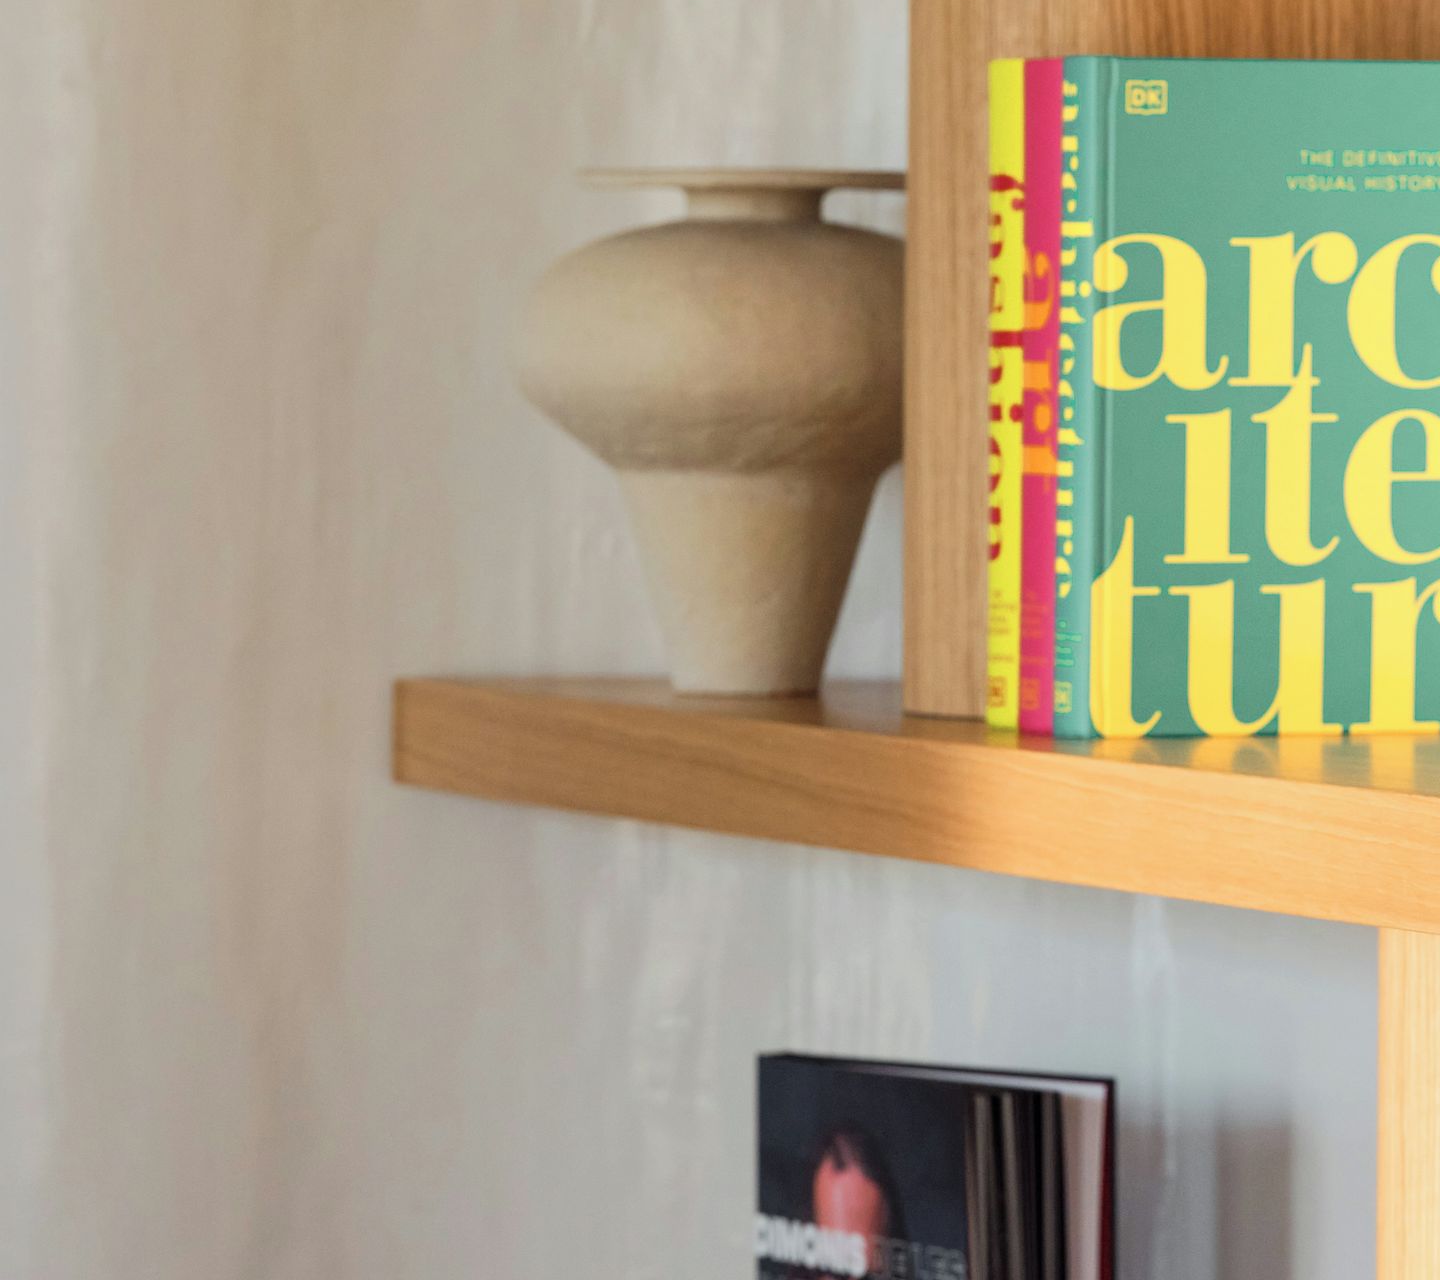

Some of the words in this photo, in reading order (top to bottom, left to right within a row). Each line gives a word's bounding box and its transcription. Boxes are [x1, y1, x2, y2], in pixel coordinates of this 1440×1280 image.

[1130, 88, 1161, 107] DK
[1300, 149, 1334, 167] THE
[1286, 175, 1356, 191] VISUAL
